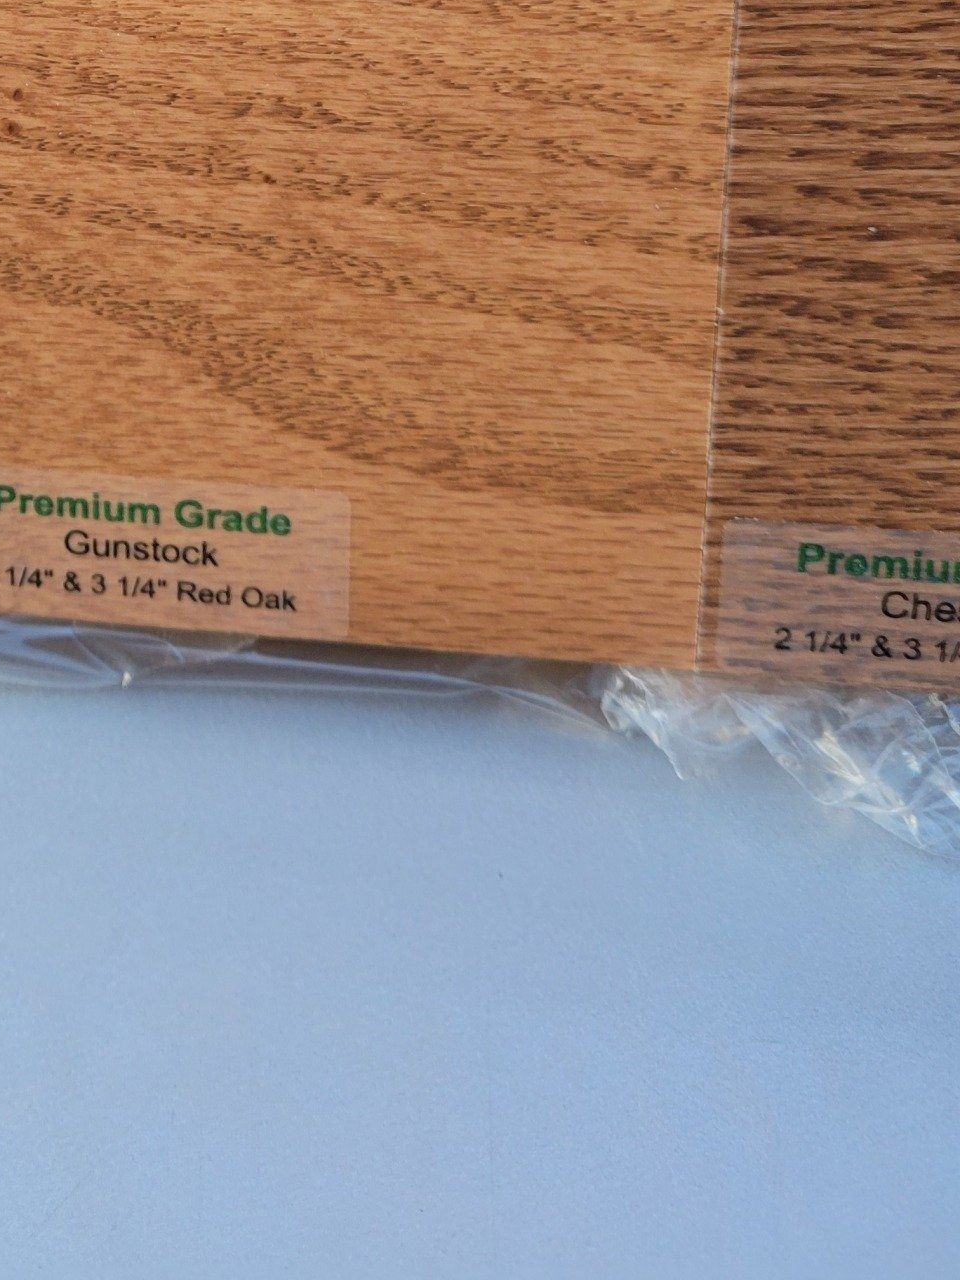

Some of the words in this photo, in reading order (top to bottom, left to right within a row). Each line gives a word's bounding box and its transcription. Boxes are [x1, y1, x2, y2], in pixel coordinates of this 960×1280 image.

[174, 499, 292, 536] Grade
[64, 530, 219, 567] Gunstock
[797, 542, 960, 584] Premiu
[6, 567, 53, 588] 1/4"
[63, 571, 82, 593] &
[91, 574, 106, 595] 3
[119, 576, 167, 598] 1/4"
[177, 581, 231, 606] Red
[241, 587, 297, 612] Oak
[881, 591, 960, 623] Che
[775, 627, 791, 651] 2
[807, 630, 861, 654] 1/4"
[871, 635, 893, 658] &
[903, 637, 922, 660] 3
[936, 640, 960, 663] 1/
